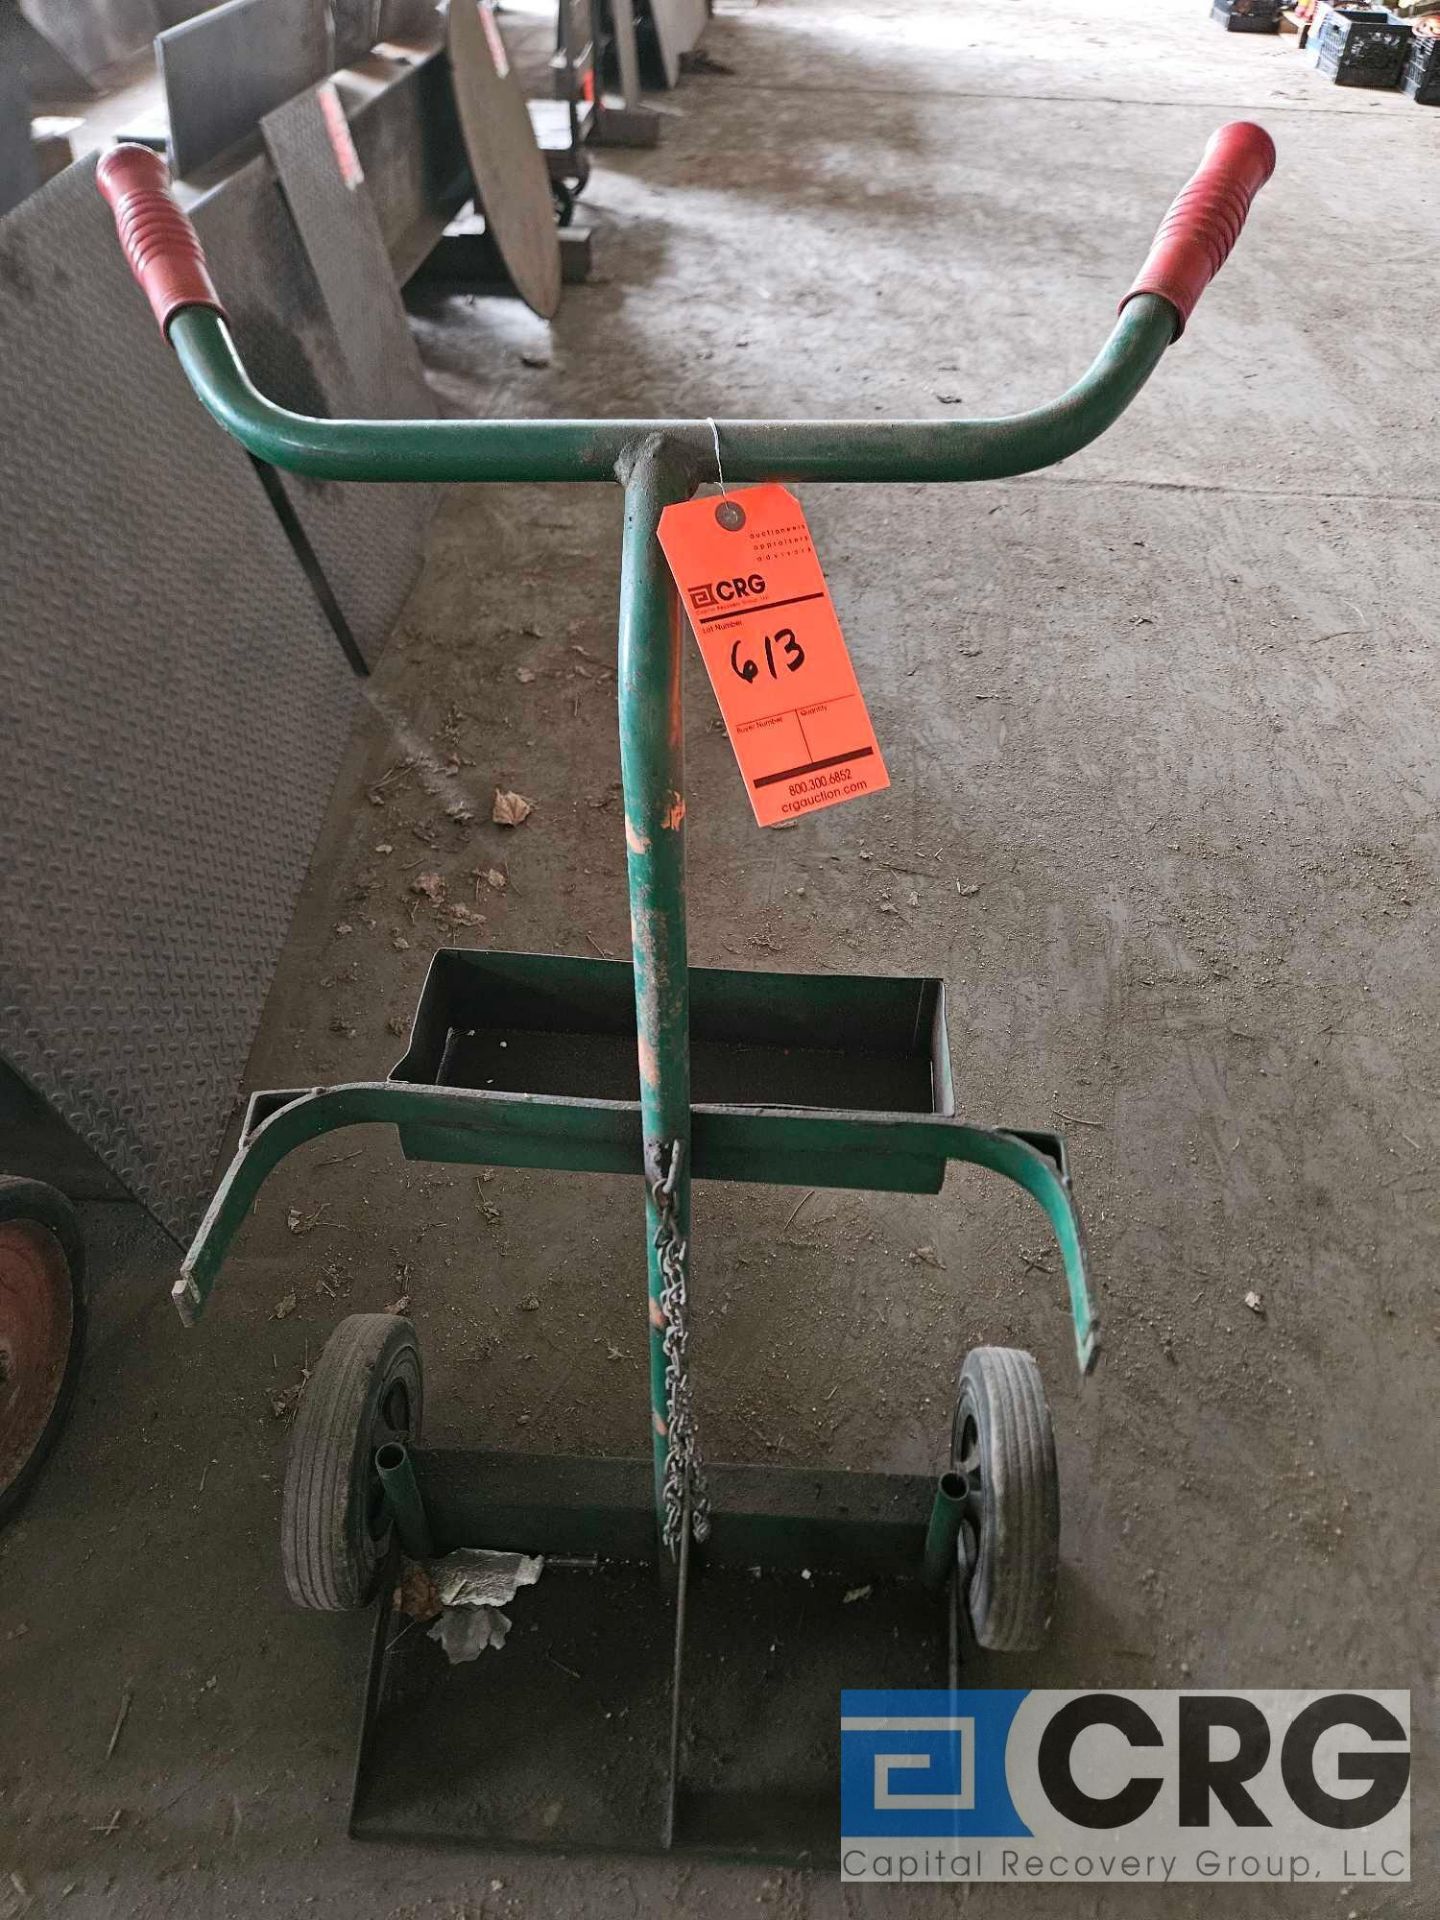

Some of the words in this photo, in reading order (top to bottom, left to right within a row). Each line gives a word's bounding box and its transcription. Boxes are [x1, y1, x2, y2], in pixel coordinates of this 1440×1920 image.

[715, 574, 766, 601] CRG
[714, 620, 743, 631] Number
[731, 628, 805, 684] 613
[781, 780, 868, 813] crgauction.com
[788, 768, 852, 797] 800.300.6852
